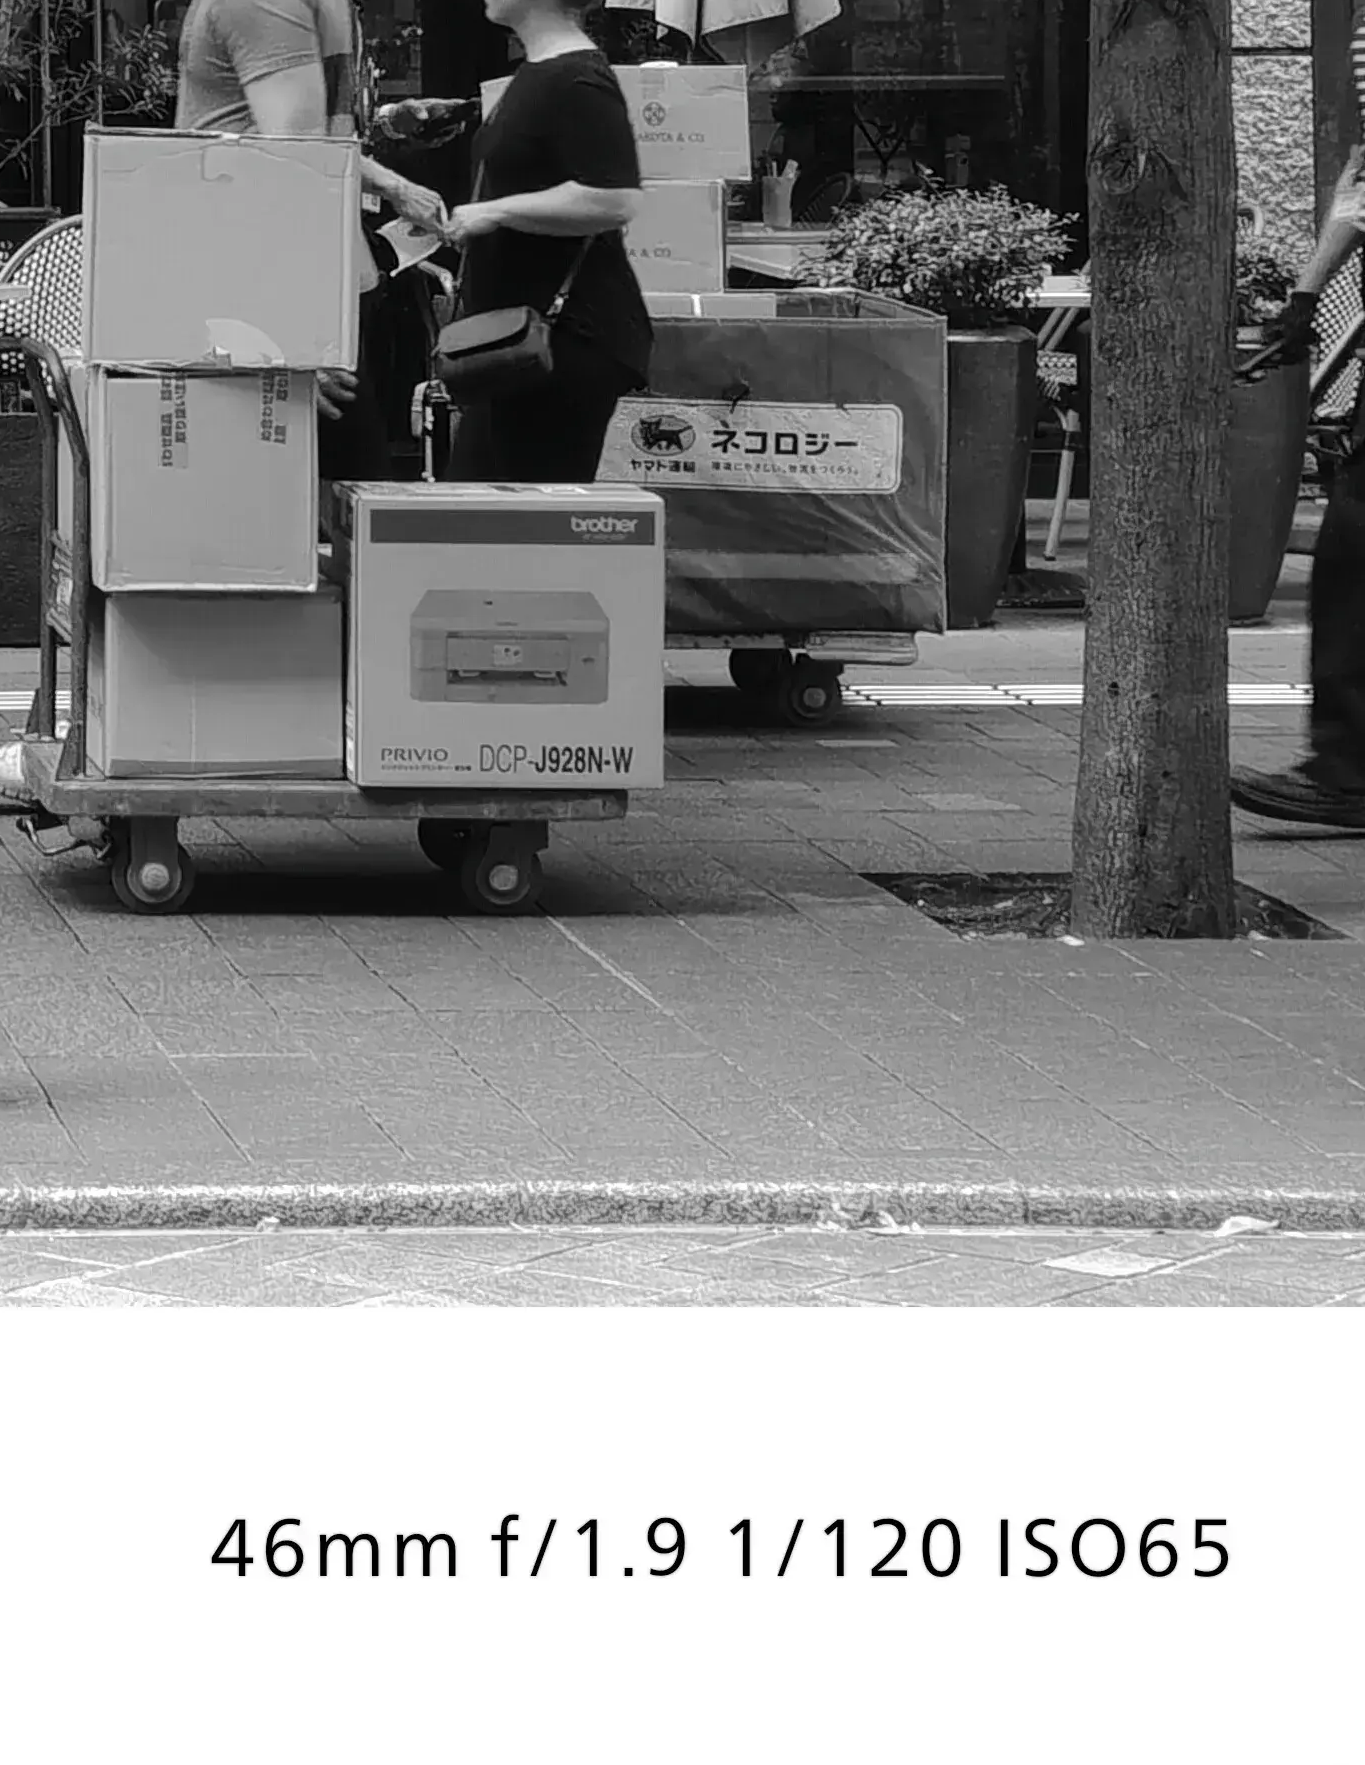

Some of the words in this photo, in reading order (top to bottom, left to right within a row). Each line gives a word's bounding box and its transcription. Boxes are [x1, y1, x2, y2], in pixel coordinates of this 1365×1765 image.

[711, 419, 859, 456] ネコロジー
[570, 516, 639, 533] brother
[381, 747, 448, 762] PRIVIO
[480, 744, 634, 774] DCP-J928N-W
